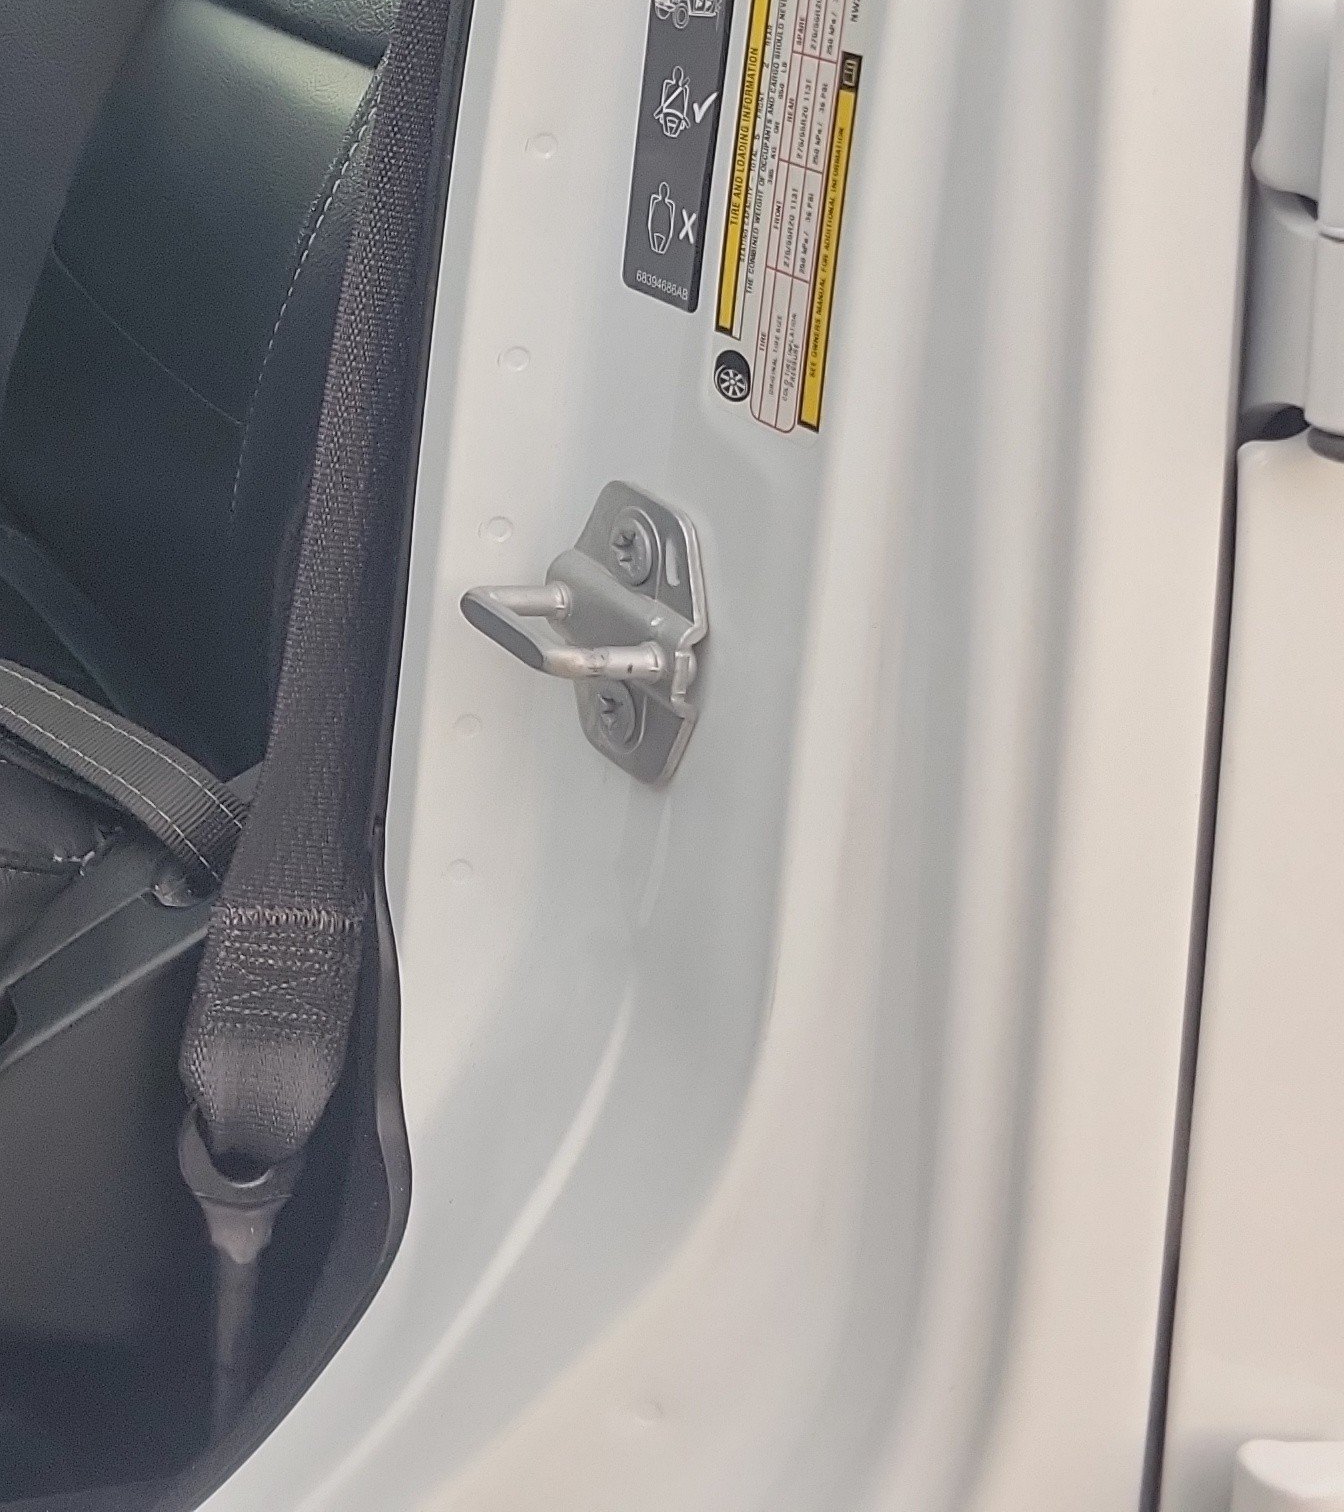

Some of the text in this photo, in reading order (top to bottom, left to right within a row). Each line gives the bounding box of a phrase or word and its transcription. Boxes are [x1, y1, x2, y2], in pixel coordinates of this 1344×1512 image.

[773, 21, 784, 60] SHOULD
[795, 15, 805, 46] SPARE
[769, 61, 779, 94] CARGO
[767, 95, 775, 115] AND
[786, 96, 795, 123] REAR
[729, 46, 758, 229] TIRE AND LOADING INFORMATION
[760, 117, 772, 173] OCCUPANTS
[758, 173, 766, 188] OF
[754, 187, 764, 225] WEIGHT
[773, 199, 782, 231] FRONT
[748, 225, 759, 275] COMBINED
[758, 329, 766, 354] TIRE
